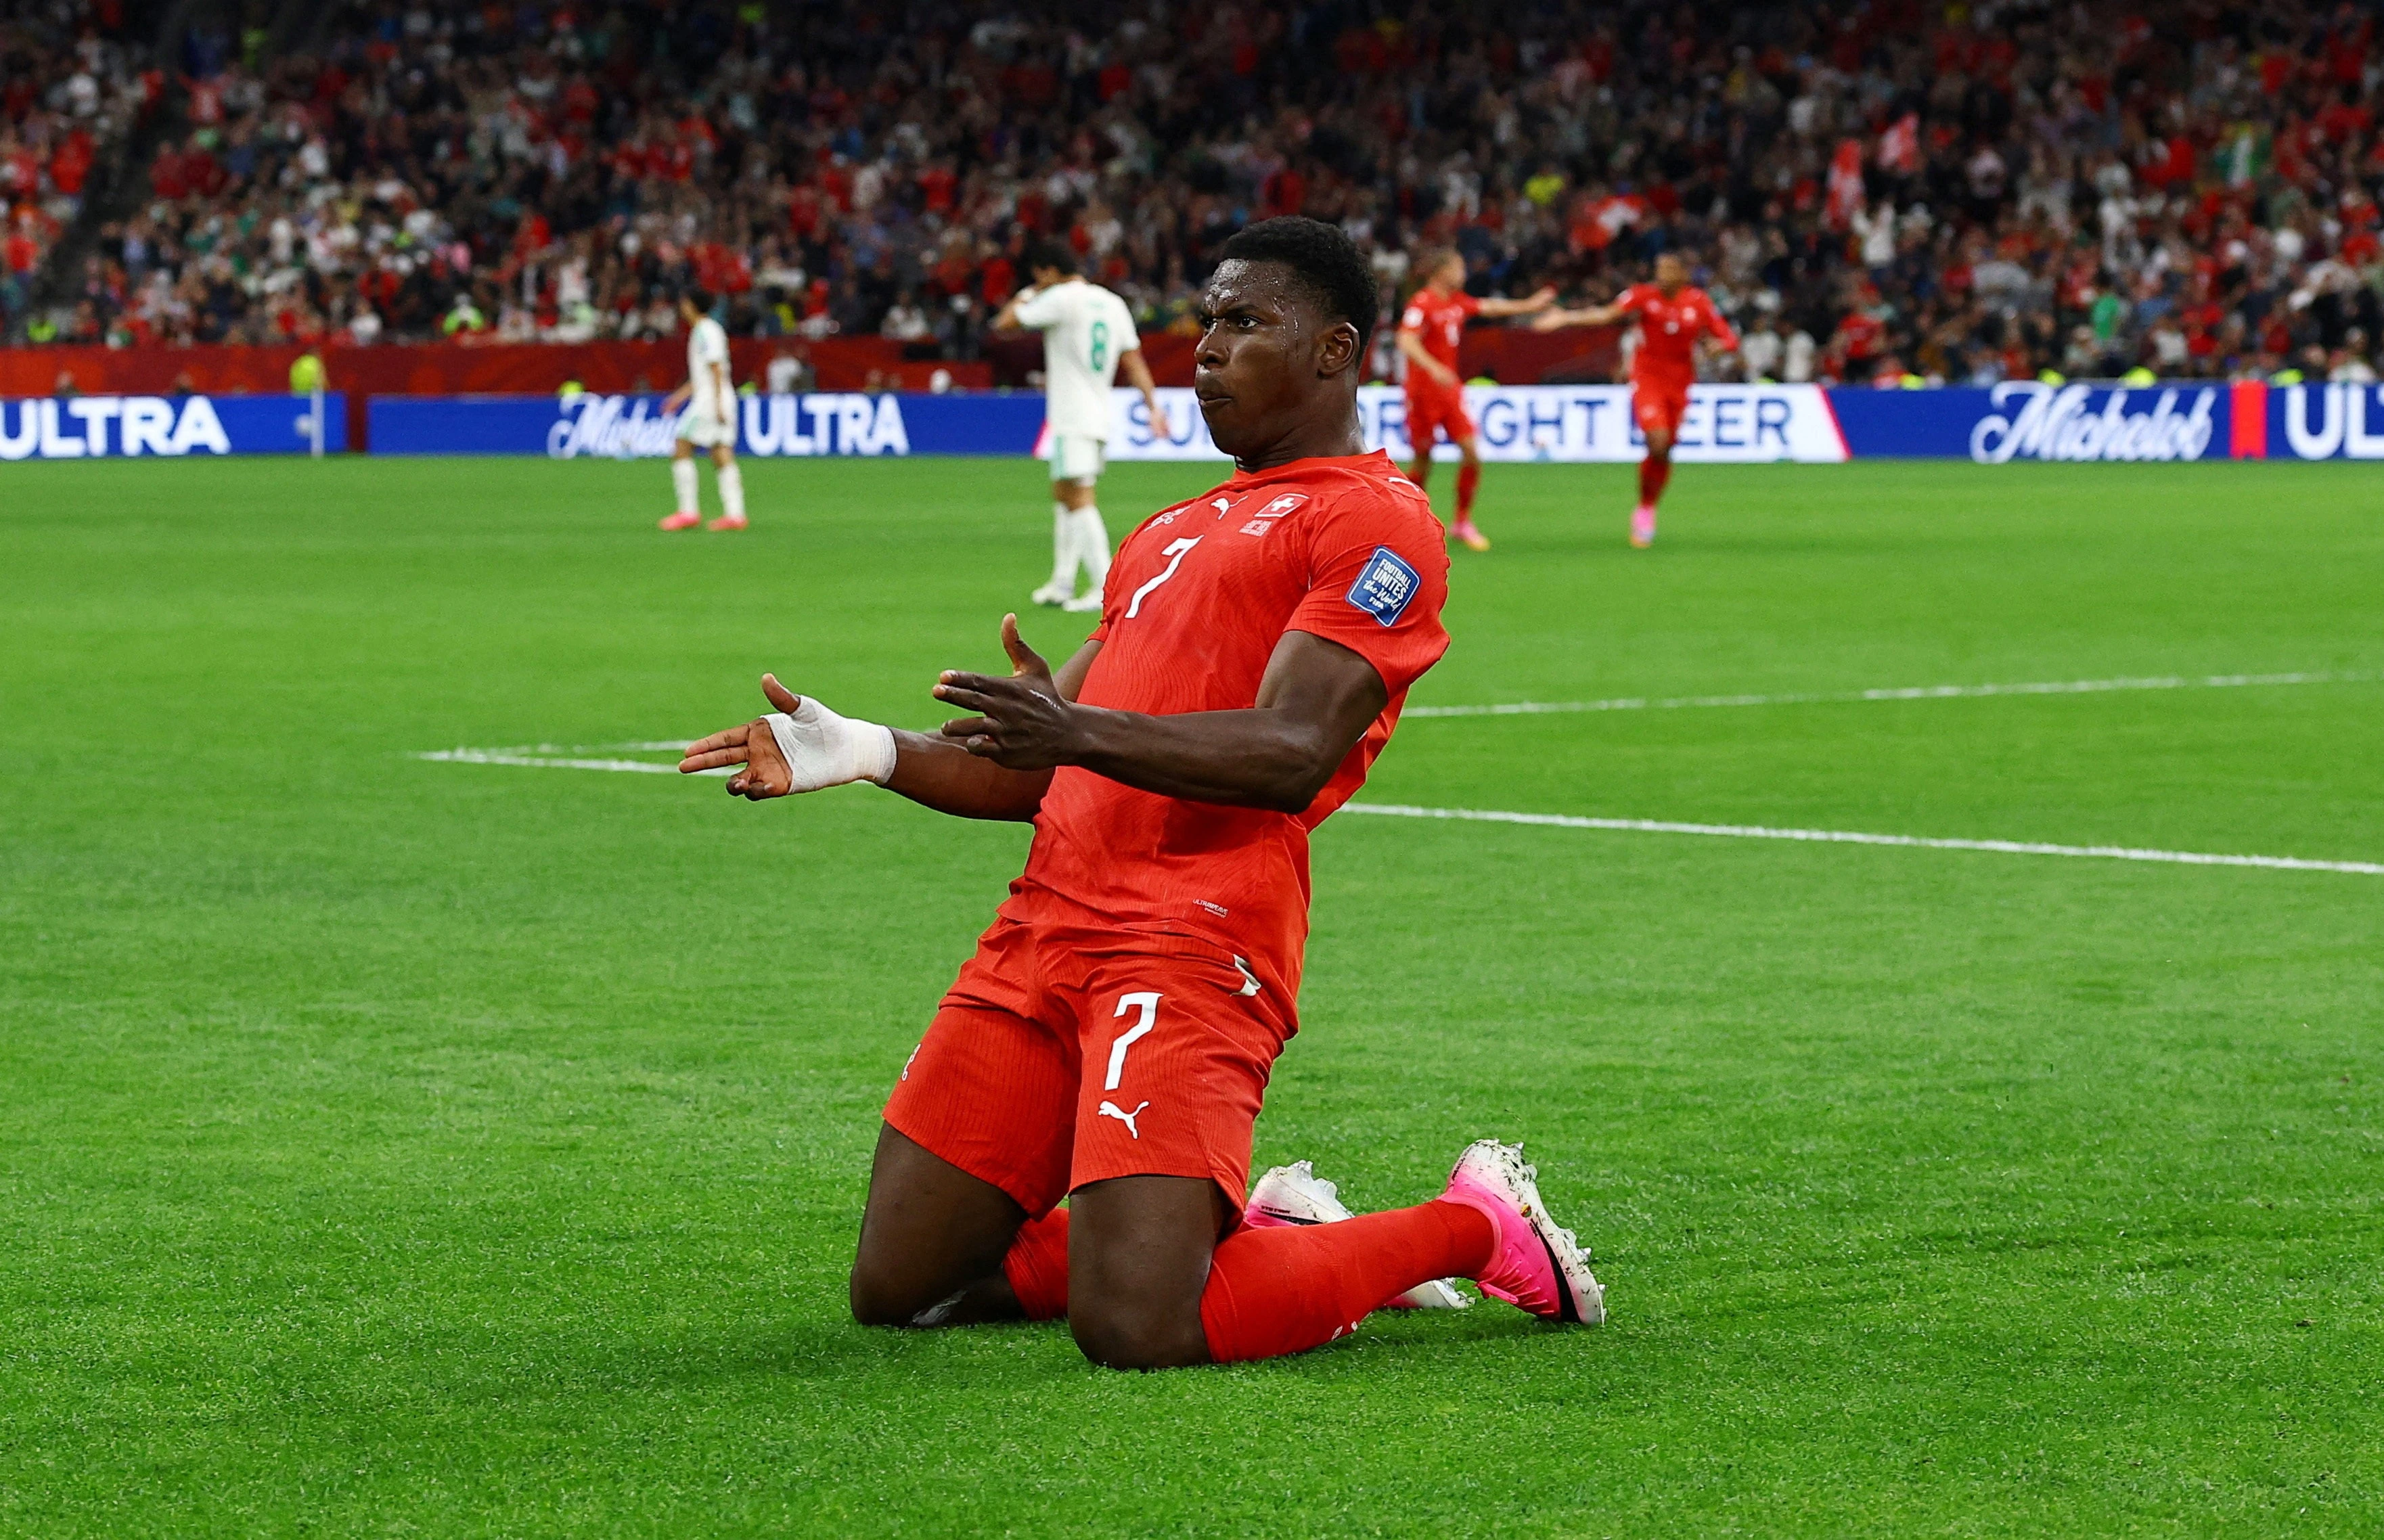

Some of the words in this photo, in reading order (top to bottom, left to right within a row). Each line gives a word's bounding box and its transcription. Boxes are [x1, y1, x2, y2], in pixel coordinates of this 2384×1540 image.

[1090, 321, 1110, 372] 8
[0, 395, 231, 459] ULTRA
[744, 393, 910, 456] ULTRA
[2285, 382, 2384, 460] UL
[1125, 535, 1205, 618] 7
[1363, 579, 1378, 594] the
[1376, 588, 1401, 612] World
[1372, 567, 1407, 600] UNITES
[1379, 558, 1412, 589] FOOTBALL
[1368, 596, 1385, 610] FIFA
[1192, 899, 1229, 915] ULTRAWEAVE
[1104, 992, 1164, 1091] 7
